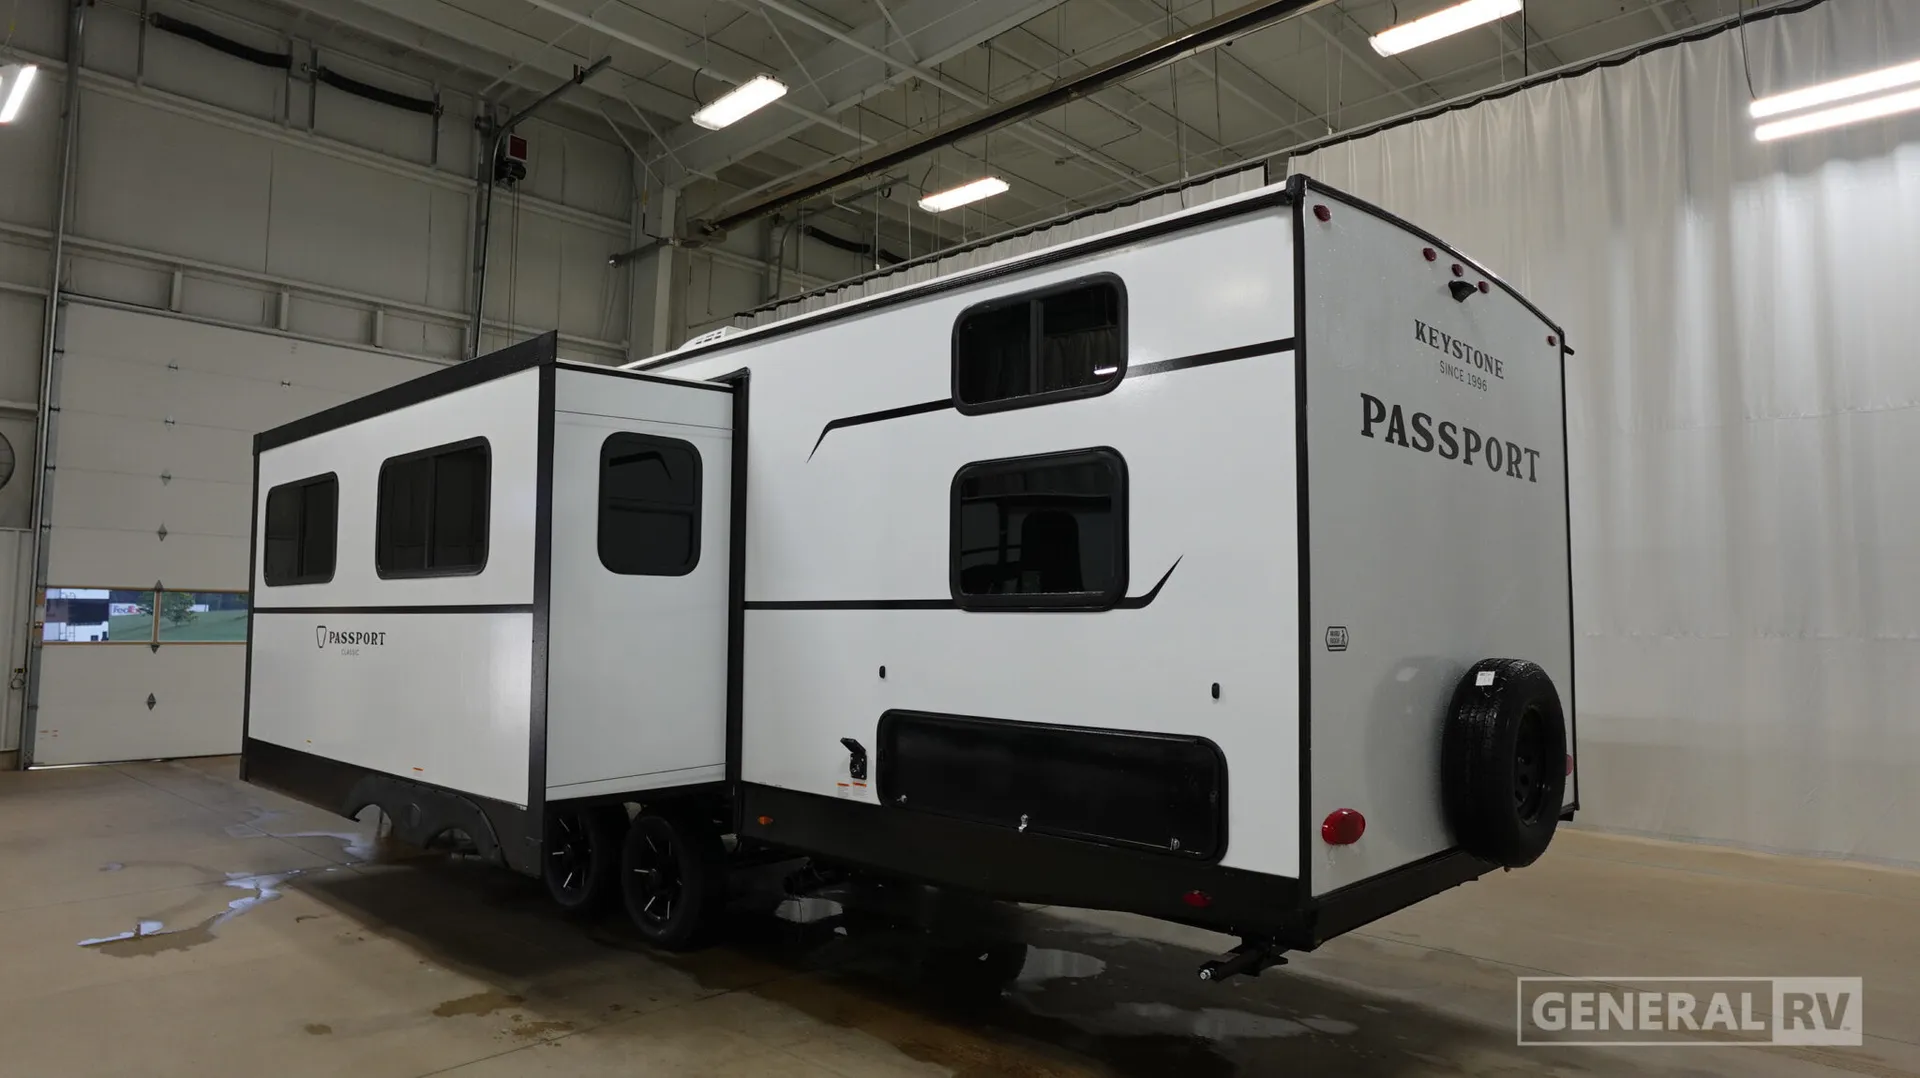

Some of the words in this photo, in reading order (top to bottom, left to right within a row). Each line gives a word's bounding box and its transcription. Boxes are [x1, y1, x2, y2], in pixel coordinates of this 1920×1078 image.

[1414, 319, 1504, 380] KEYSTONE
[1439, 360, 1464, 383] SINCE
[1467, 372, 1488, 392] 1996
[1360, 392, 1540, 483] PASSPORT
[329, 631, 386, 645] PASSPORT
